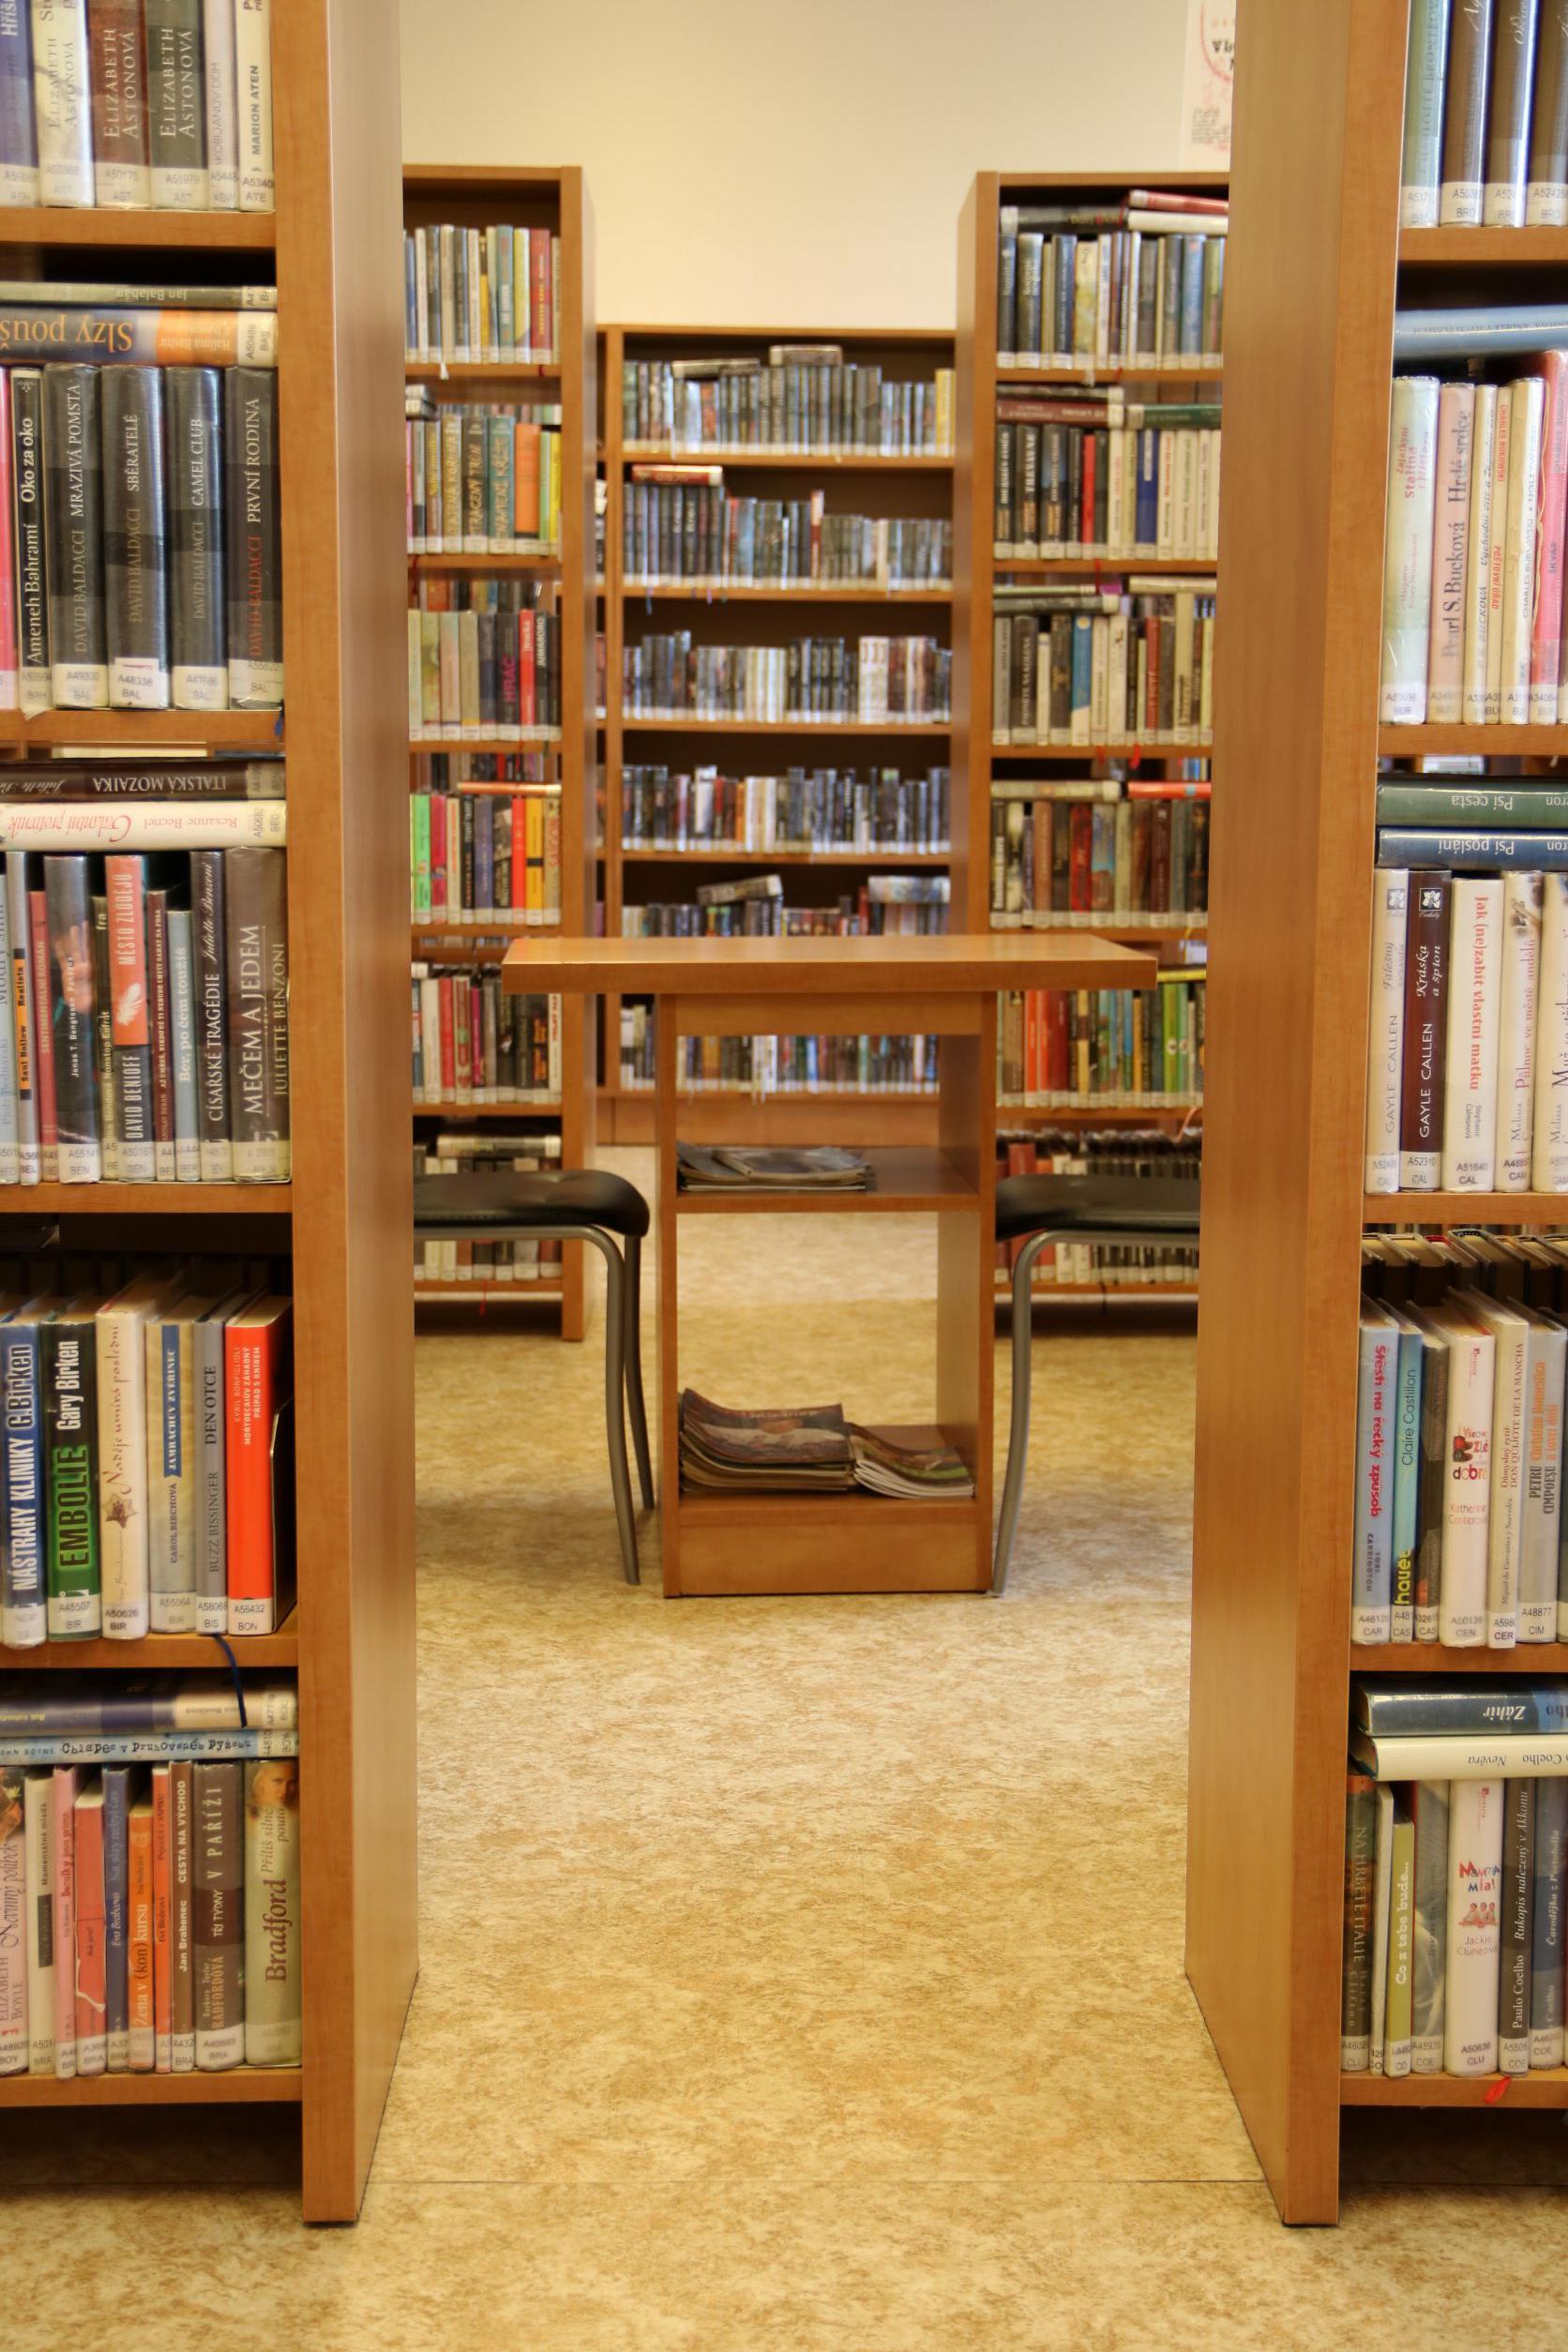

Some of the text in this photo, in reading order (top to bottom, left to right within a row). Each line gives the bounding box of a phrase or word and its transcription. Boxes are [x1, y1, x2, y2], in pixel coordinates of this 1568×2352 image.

[104, 28, 120, 139] ELIZABETH
[120, 31, 139, 139] ASTONOVÁ
[160, 28, 176, 139] ELIZABETH
[177, 30, 195, 139] ASTONOVÁ
[249, 65, 261, 156] MARION ATEN
[76, 315, 133, 353] Slzy
[21, 418, 37, 503] Oko za oko
[68, 384, 84, 517] MRAZIVÁ POMSTA
[191, 418, 205, 505] CAMEL CLUB
[247, 399, 262, 522] PRVNÍ RODINA
[1448, 411, 1471, 503] Hrdé srdce
[127, 508, 142, 576] BALDACCI
[1443, 521, 1466, 612] S. Bucková
[23, 523, 42, 664] Ameneh Bahramí
[72, 530, 88, 652] DAVID BALDACCI
[248, 535, 262, 608] BALDACCI
[93, 776, 227, 795] ITALSKÁ MOZAIKA
[1451, 796, 1514, 810] Psí cesta
[1438, 839, 1515, 855] Psí poslání
[97, 913, 108, 930] fra
[202, 864, 219, 964] Juliette Benzoni
[116, 927, 137, 965] MĚSTO
[1417, 945, 1429, 997] Kráska
[16, 965, 26, 1006] Realista
[1434, 988, 1441, 997] a
[1470, 897, 1490, 1091] Jak (ne)zabít vlastní matku
[180, 1031, 193, 1049] po
[239, 925, 264, 1114] MEČEM A JEDEM
[270, 942, 288, 1095] JULIETTE BENZONI
[20, 1062, 29, 1081] Saul
[68, 1042, 81, 1078] Jonas T.
[104, 1041, 113, 1079] Nonstop
[180, 1053, 193, 1081] Ber,
[204, 973, 225, 1122] CÍSAŘSKÉ TRAGÉDIE
[123, 1056, 144, 1139] DAVID BENIOFF
[1386, 1015, 1399, 1133] GAYLE CALLEN
[1420, 1023, 1433, 1138] GAYLE CALLEN
[1512, 1103, 1523, 1141] Melissa
[1550, 1105, 1563, 1143] Melissa
[1459, 1176, 1477, 1184] CAL
[8, 1345, 34, 1429] G.Birken
[56, 1341, 84, 1430] Gary Birken
[1515, 1343, 1525, 1386] MANCHA
[204, 1365, 218, 1444] DEN OTCE
[1375, 1390, 1383, 1410] na
[1403, 1369, 1418, 1466] Claire Castillon
[1514, 1406, 1521, 1417] DE
[1515, 1388, 1522, 1404] LA
[1512, 1419, 1521, 1463] QUIJOTE
[9, 1437, 37, 1500] KLINIKY
[1370, 1464, 1387, 1516] způsob
[1530, 1466, 1543, 1498] PETRU
[56, 1445, 91, 1566] EMBOLIE
[208, 1471, 219, 1573] BUZZ BISSINGER
[8, 1506, 38, 1591] NÁSTRAHY
[110, 1622, 127, 1631] BIR
[204, 1619, 219, 1628] BIS
[238, 1621, 258, 1631] BON
[1364, 1627, 1382, 1636] CAR
[1521, 1607, 1552, 1619] A48877
[1529, 1625, 1545, 1635] CIM
[1483, 1706, 1527, 1721] Záhir
[1468, 1755, 1507, 1766] Nevěra
[1523, 1755, 1561, 1765] Coelho
[176, 1780, 188, 1883] CESTA NA VÝCHOD
[204, 1787, 223, 1879] V PAŘÍŽI
[1355, 1827, 1366, 1848] NA
[1519, 1791, 1530, 1832] Akkonu
[1516, 1845, 1530, 1893] nalezený
[213, 1889, 225, 1921] TÝDNY
[263, 1878, 294, 1981] Bradford
[1515, 1896, 1527, 1940] Rukopis
[1548, 1893, 1560, 1945] Čarodějka
[113, 1930, 122, 1947] Eva
[179, 1900, 188, 1972] Jan Brabenec
[1395, 1916, 1409, 1984] Co z tebe
[1514, 1954, 1525, 2028] Paulo Coelho
